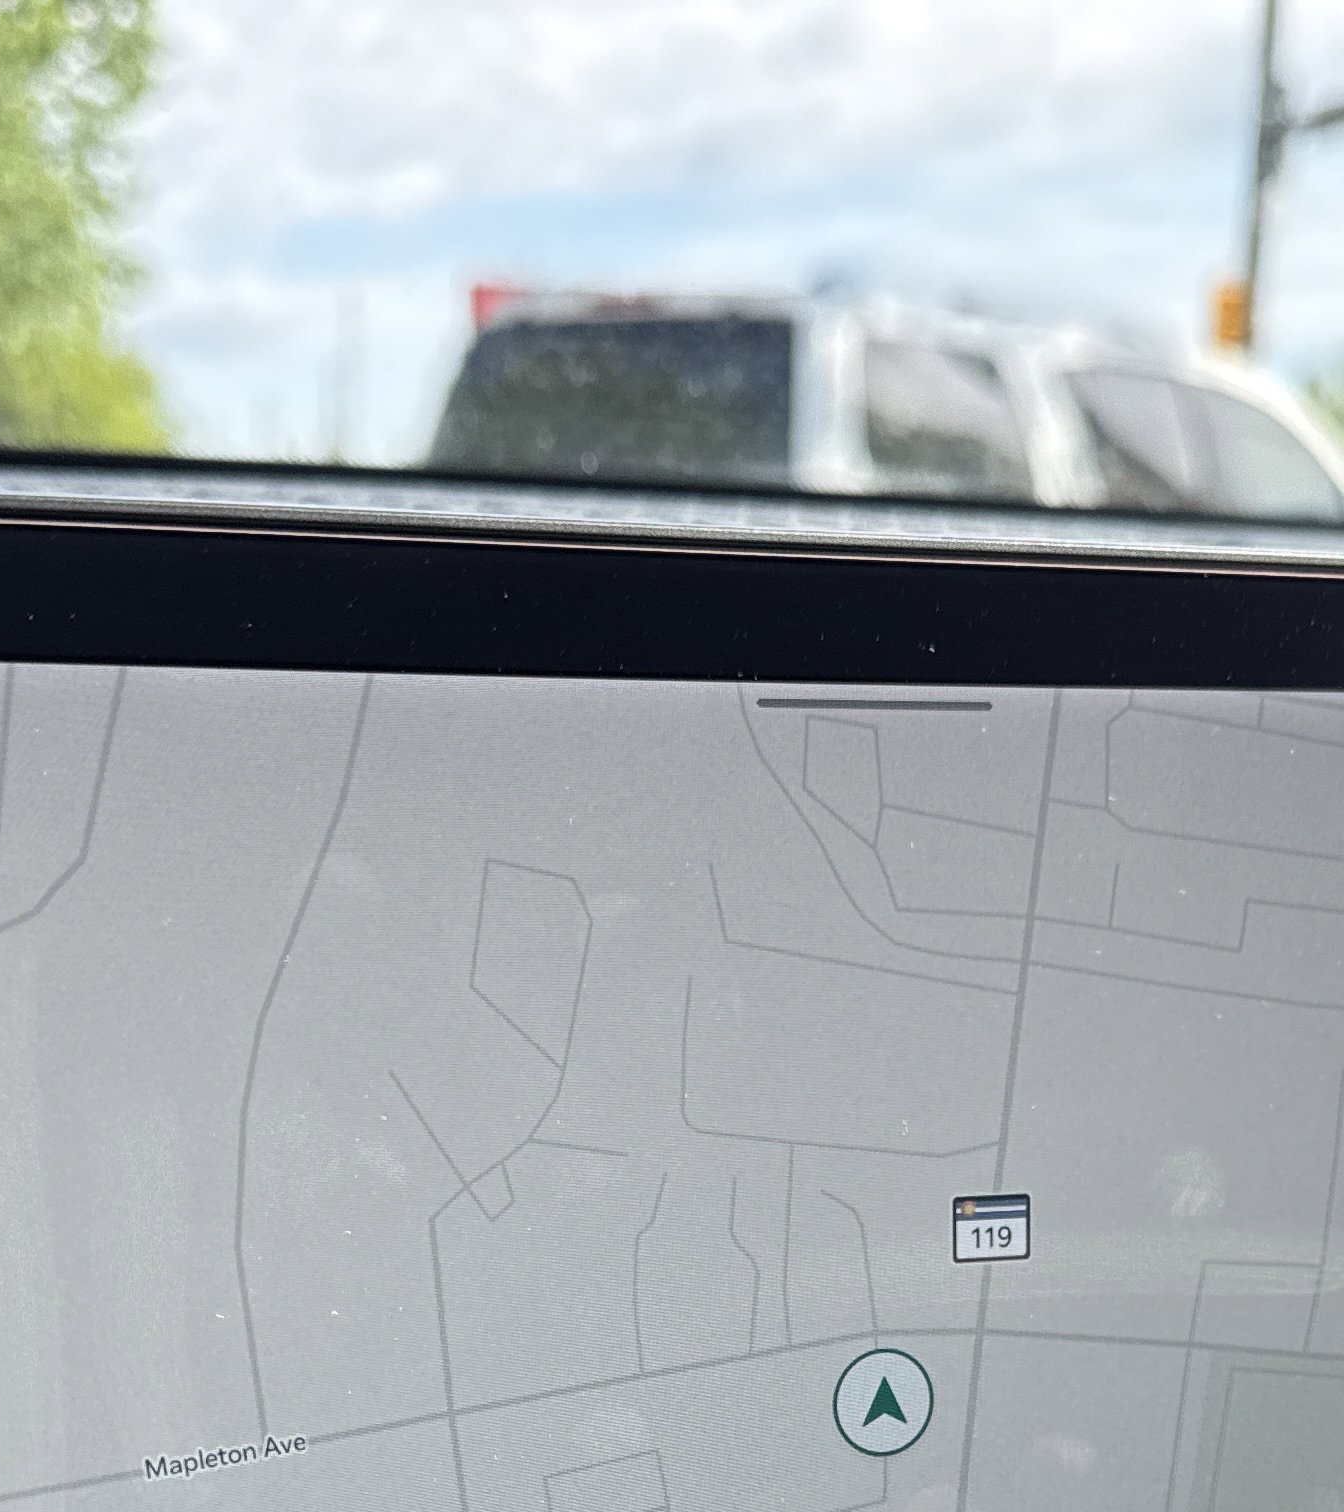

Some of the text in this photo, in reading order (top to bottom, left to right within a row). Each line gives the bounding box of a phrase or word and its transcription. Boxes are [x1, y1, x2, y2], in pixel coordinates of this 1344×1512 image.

[971, 1226, 1012, 1249] 119
[144, 1436, 306, 1480] Mapleton Ave
